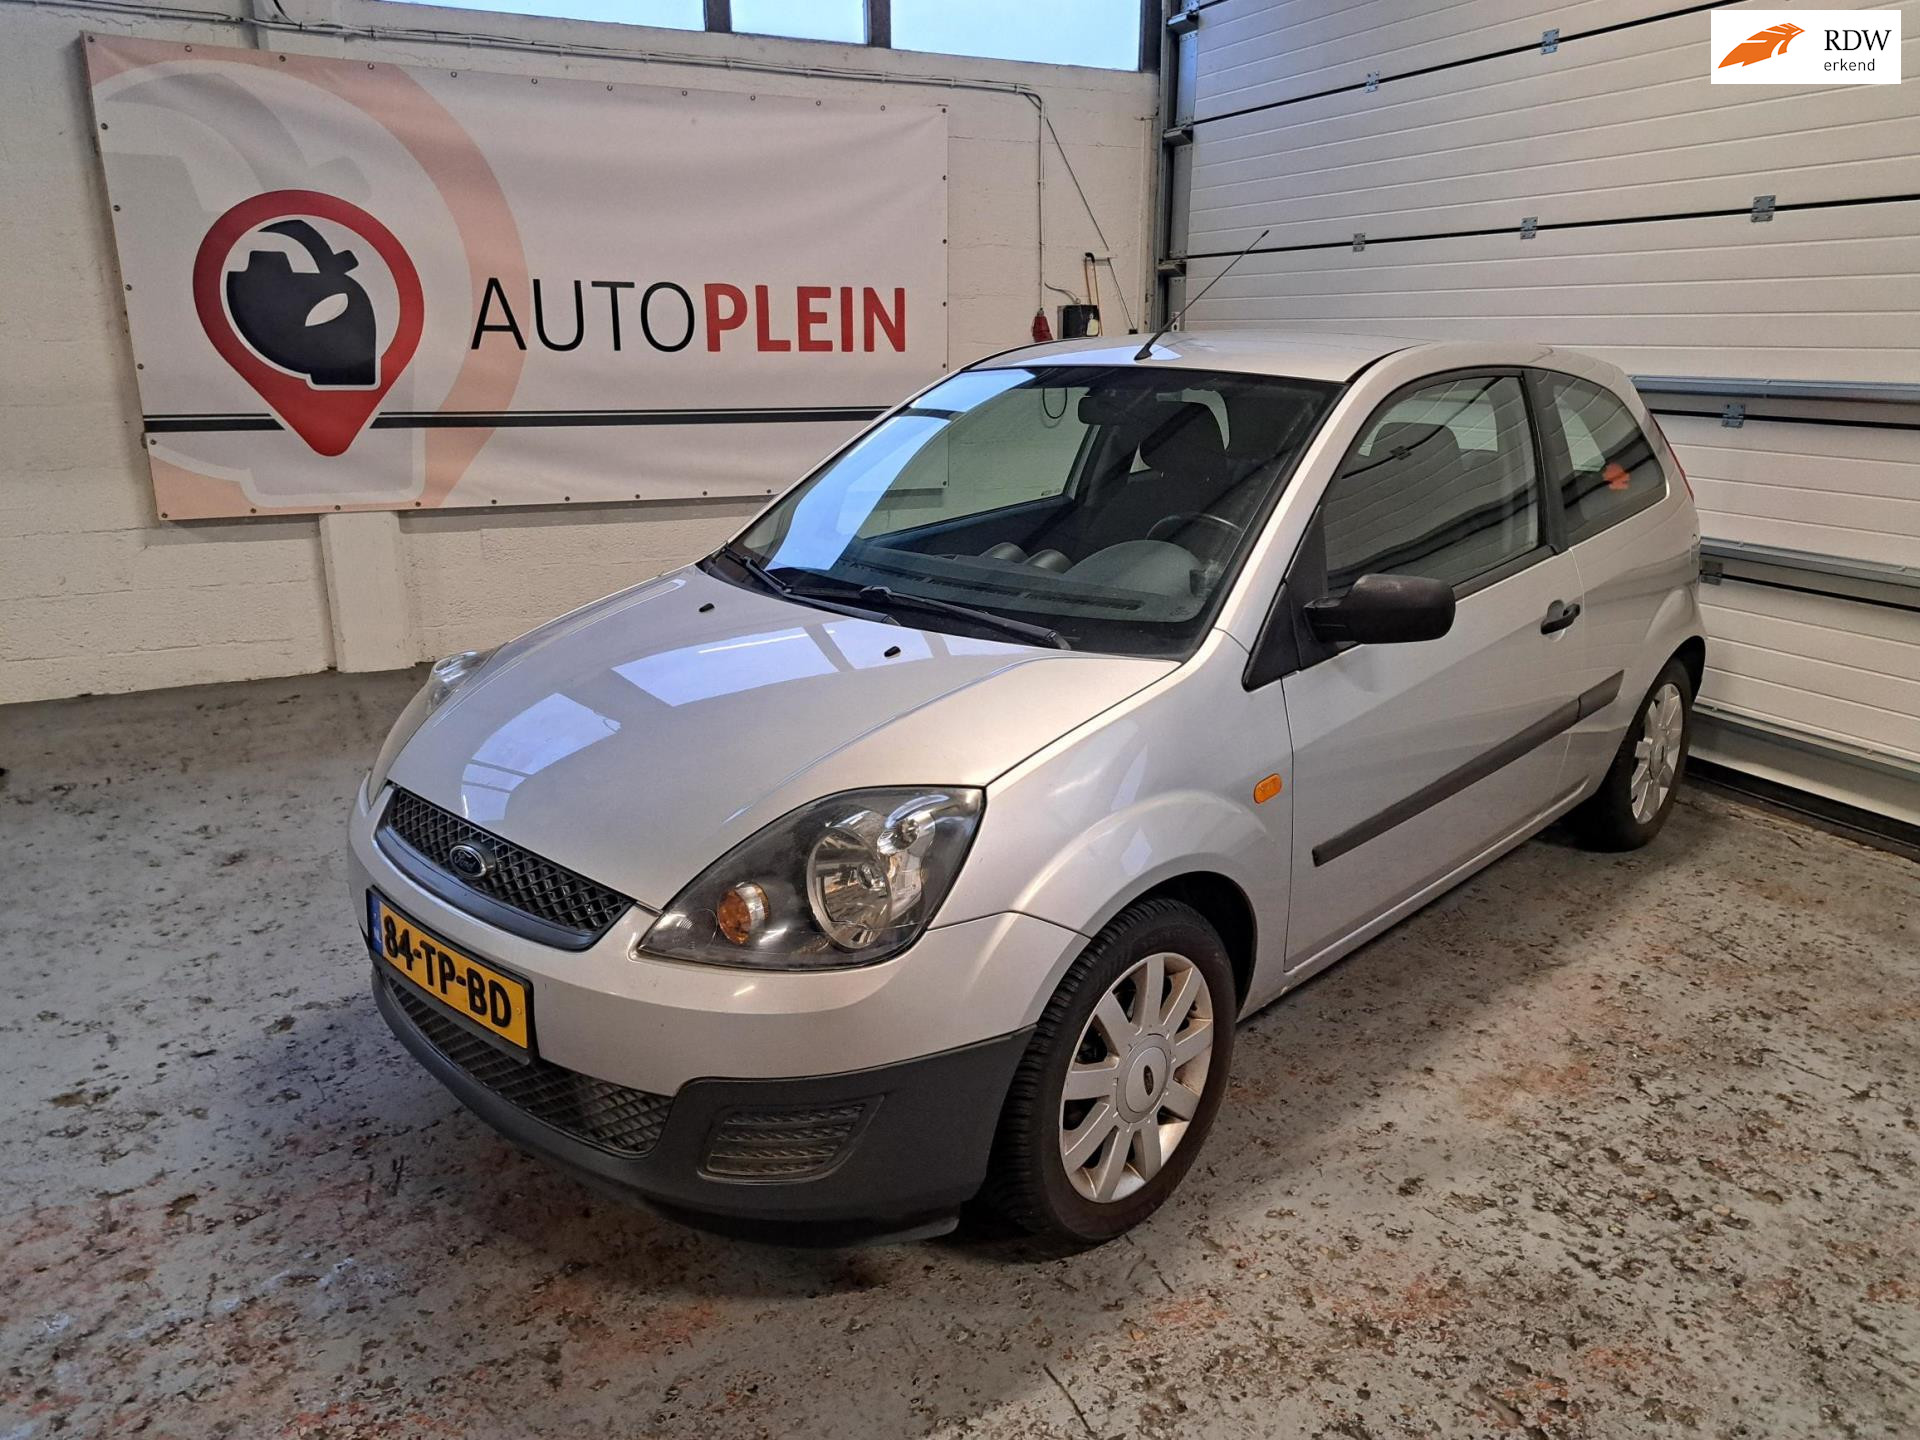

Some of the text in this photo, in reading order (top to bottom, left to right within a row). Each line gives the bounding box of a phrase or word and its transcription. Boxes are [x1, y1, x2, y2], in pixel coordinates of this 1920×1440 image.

[470, 276, 906, 353] AUTOPLEIN
[453, 850, 479, 872] Ford
[383, 914, 513, 1029] 84-TP-BD
